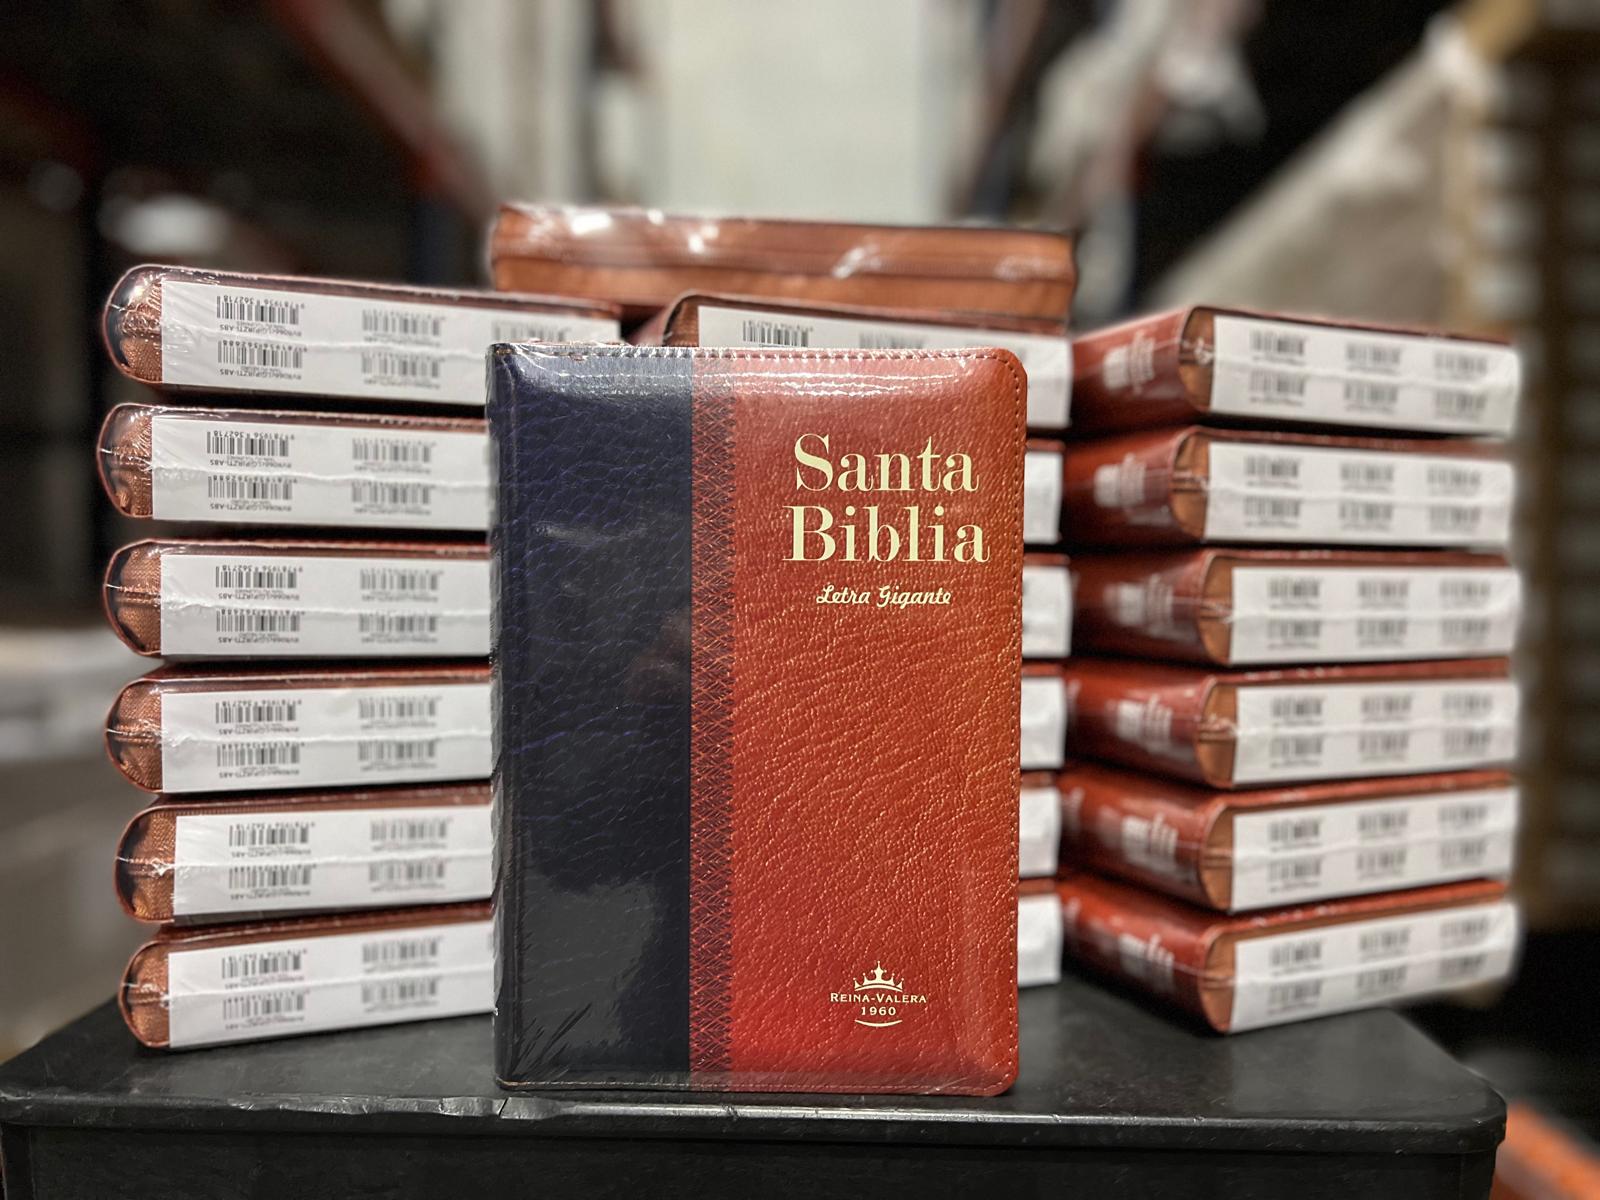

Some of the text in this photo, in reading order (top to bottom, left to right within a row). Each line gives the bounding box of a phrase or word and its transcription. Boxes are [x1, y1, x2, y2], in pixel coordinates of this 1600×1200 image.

[794, 433, 980, 492] Santa
[782, 505, 991, 563] Biblia
[816, 584, 952, 609] Letra Gigante
[830, 992, 927, 1004] REINA-VALERA
[861, 1006, 897, 1016] 1960
